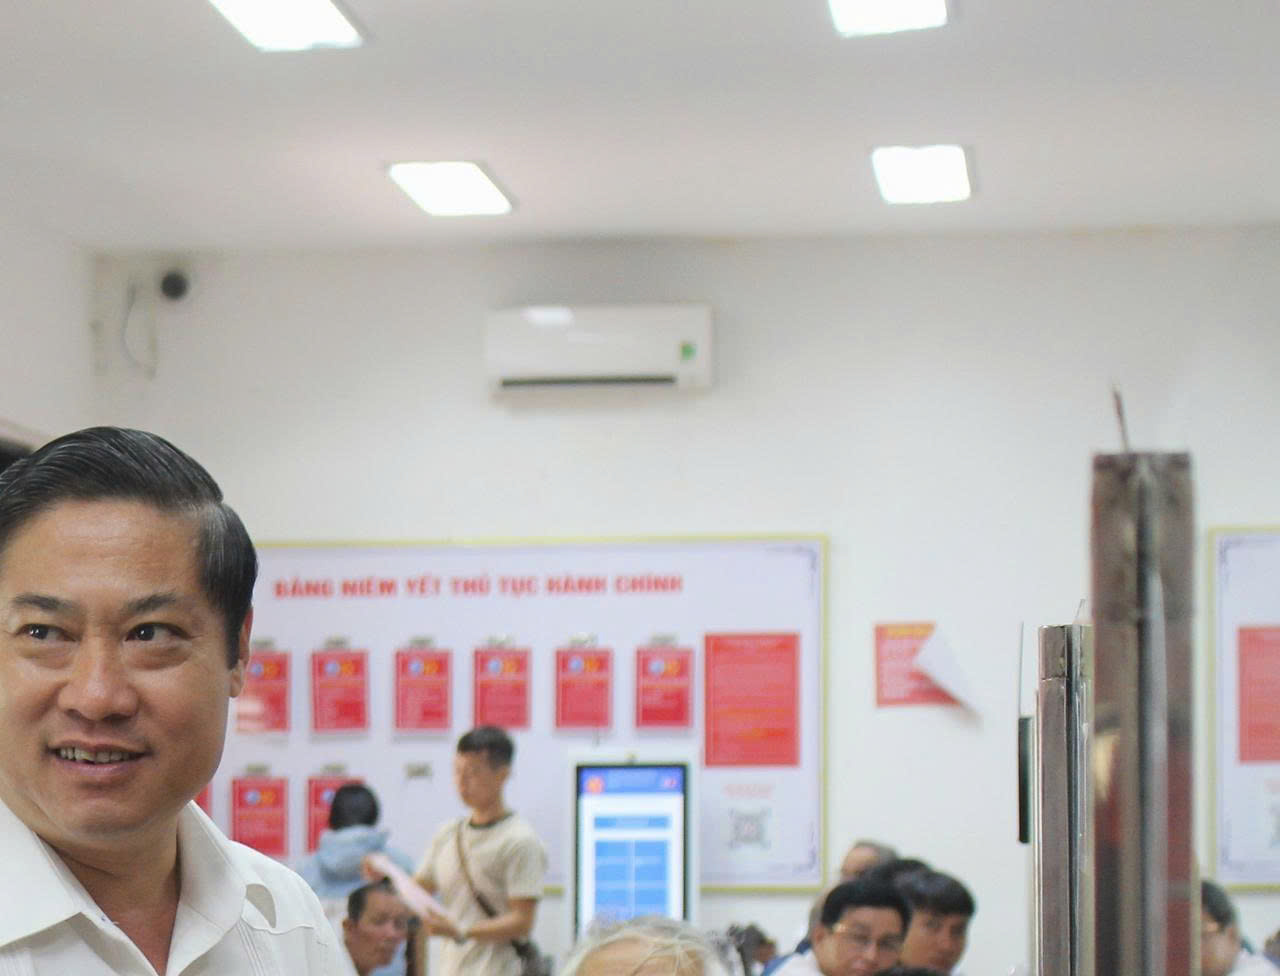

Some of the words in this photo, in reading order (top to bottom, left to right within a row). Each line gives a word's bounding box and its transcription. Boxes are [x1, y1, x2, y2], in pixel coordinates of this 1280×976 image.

[275, 575, 333, 598] BẢNG
[405, 571, 441, 597] YẾT
[451, 571, 491, 596] THỦ
[545, 572, 605, 596] HÀNH
[614, 571, 683, 596] CHÍNH
